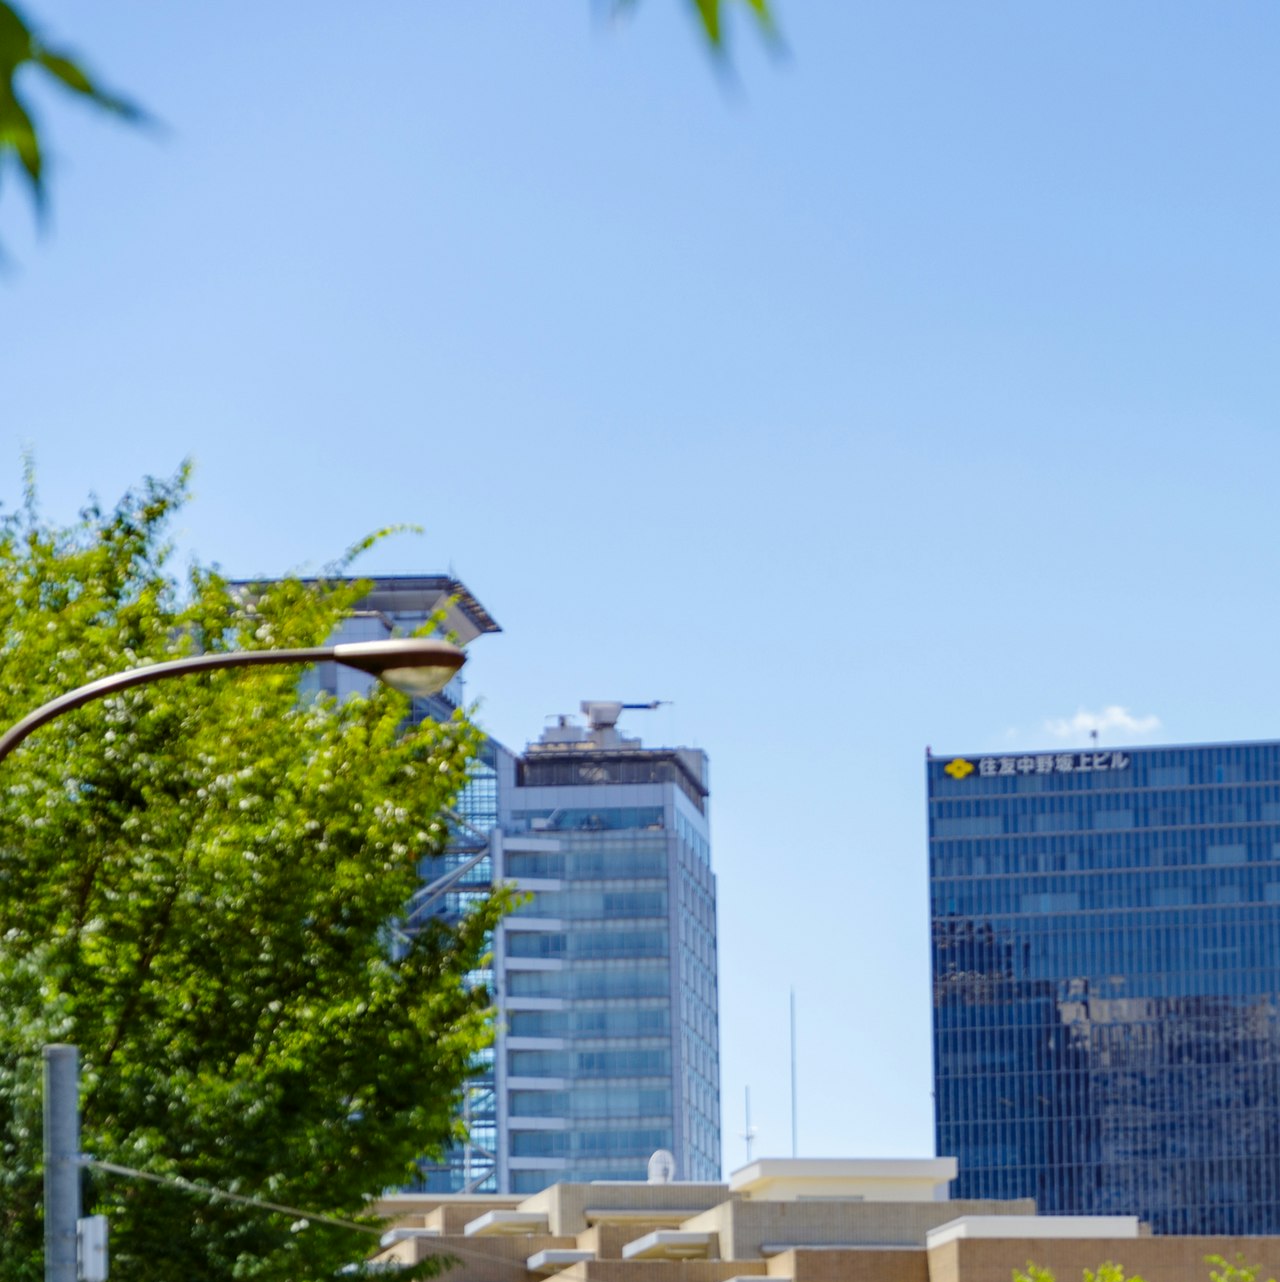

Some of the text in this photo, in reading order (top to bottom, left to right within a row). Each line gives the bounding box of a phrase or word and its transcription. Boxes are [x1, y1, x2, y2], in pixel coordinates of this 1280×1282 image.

[978, 752, 1130, 776] 住友中野坂上ビル
